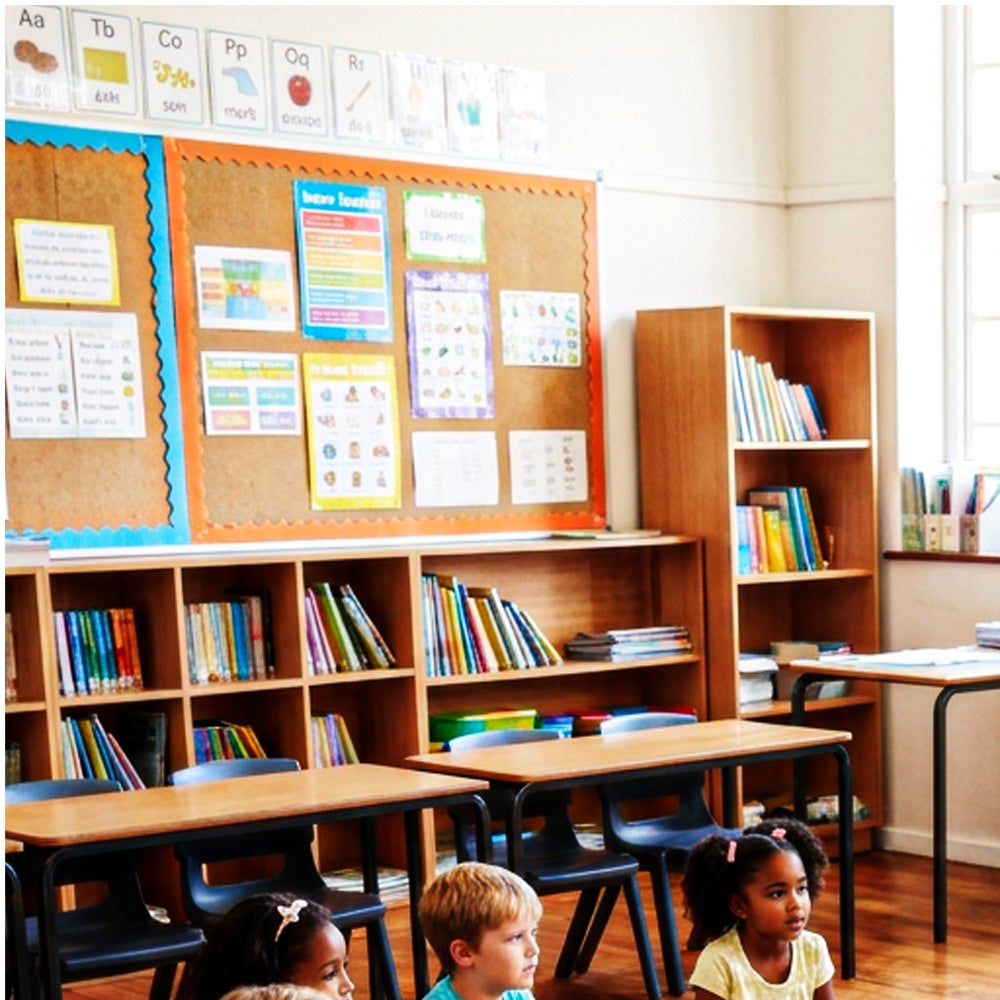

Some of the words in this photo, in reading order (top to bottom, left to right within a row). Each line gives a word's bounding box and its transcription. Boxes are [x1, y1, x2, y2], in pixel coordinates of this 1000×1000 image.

[19, 9, 45, 29] Aa
[91, 18, 115, 38] Tb
[158, 29, 183, 49] Co
[225, 38, 248, 61] Pp
